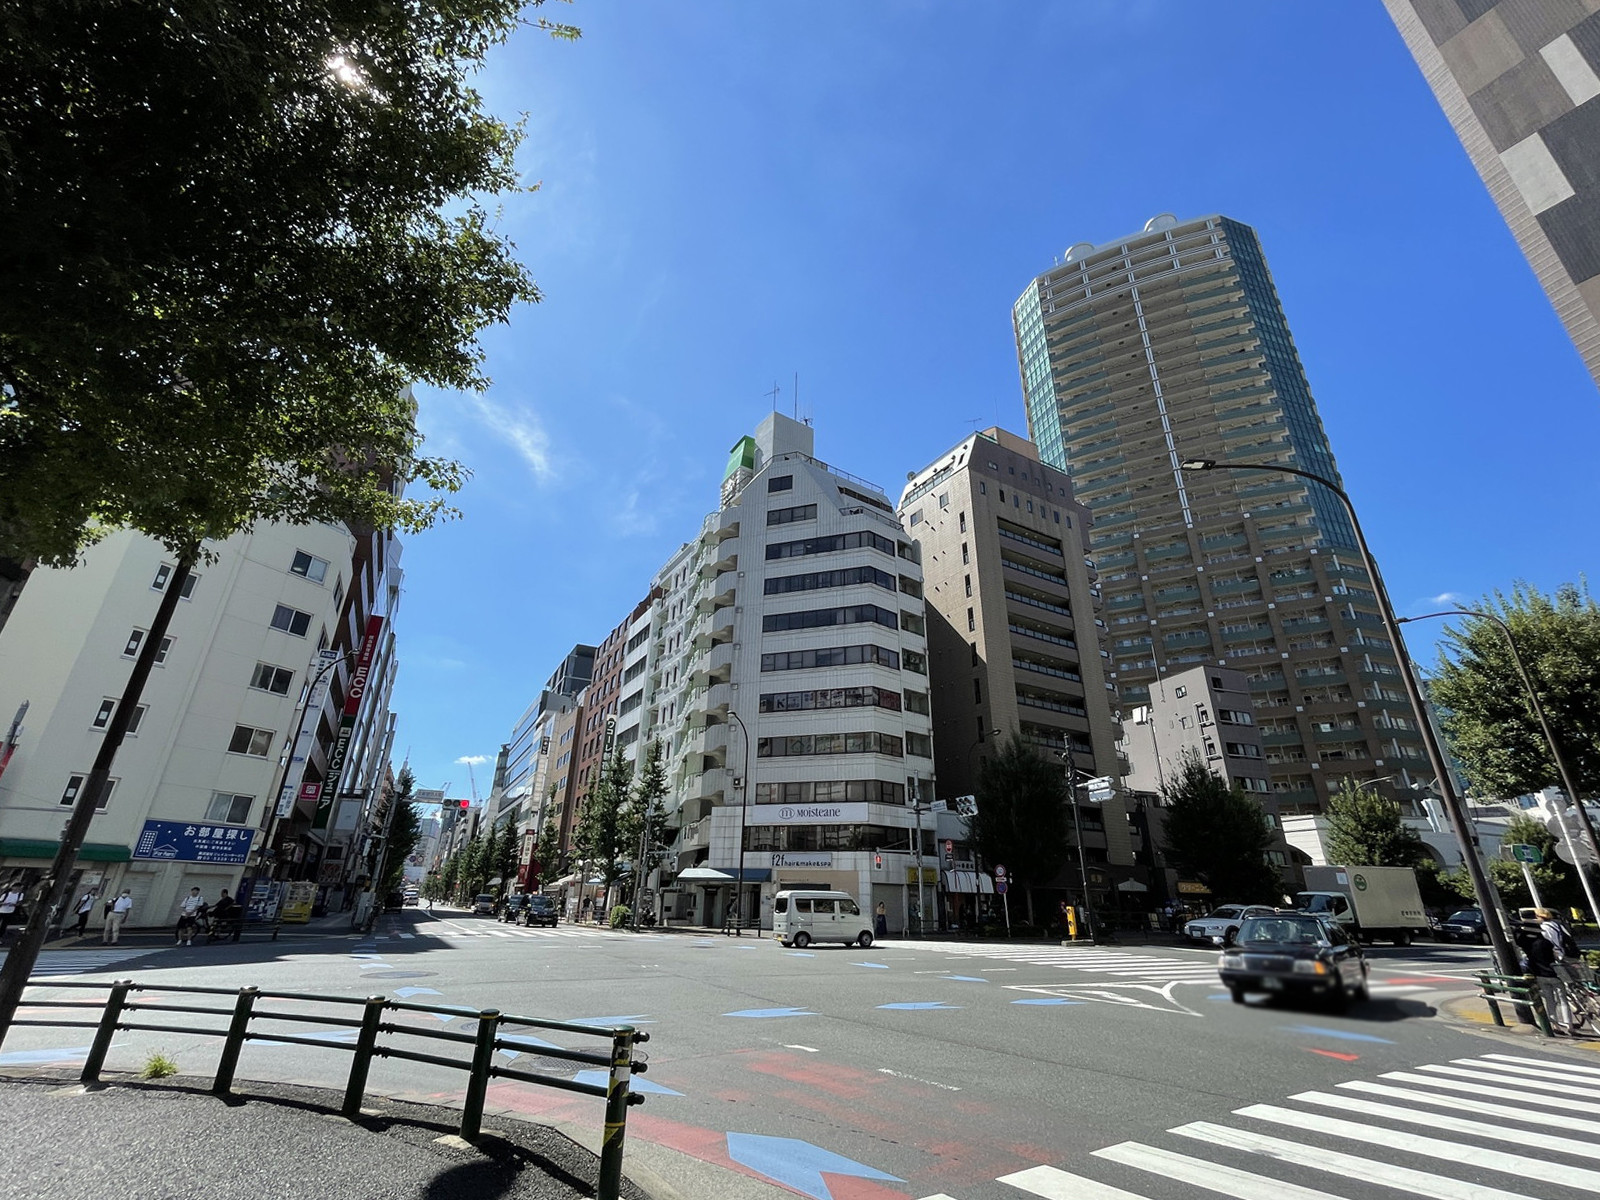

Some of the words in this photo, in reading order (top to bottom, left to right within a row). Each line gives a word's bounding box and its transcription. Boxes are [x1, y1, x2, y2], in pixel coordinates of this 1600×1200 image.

[350, 666, 368, 698] ECC
[184, 826, 247, 840] お部屋探し
